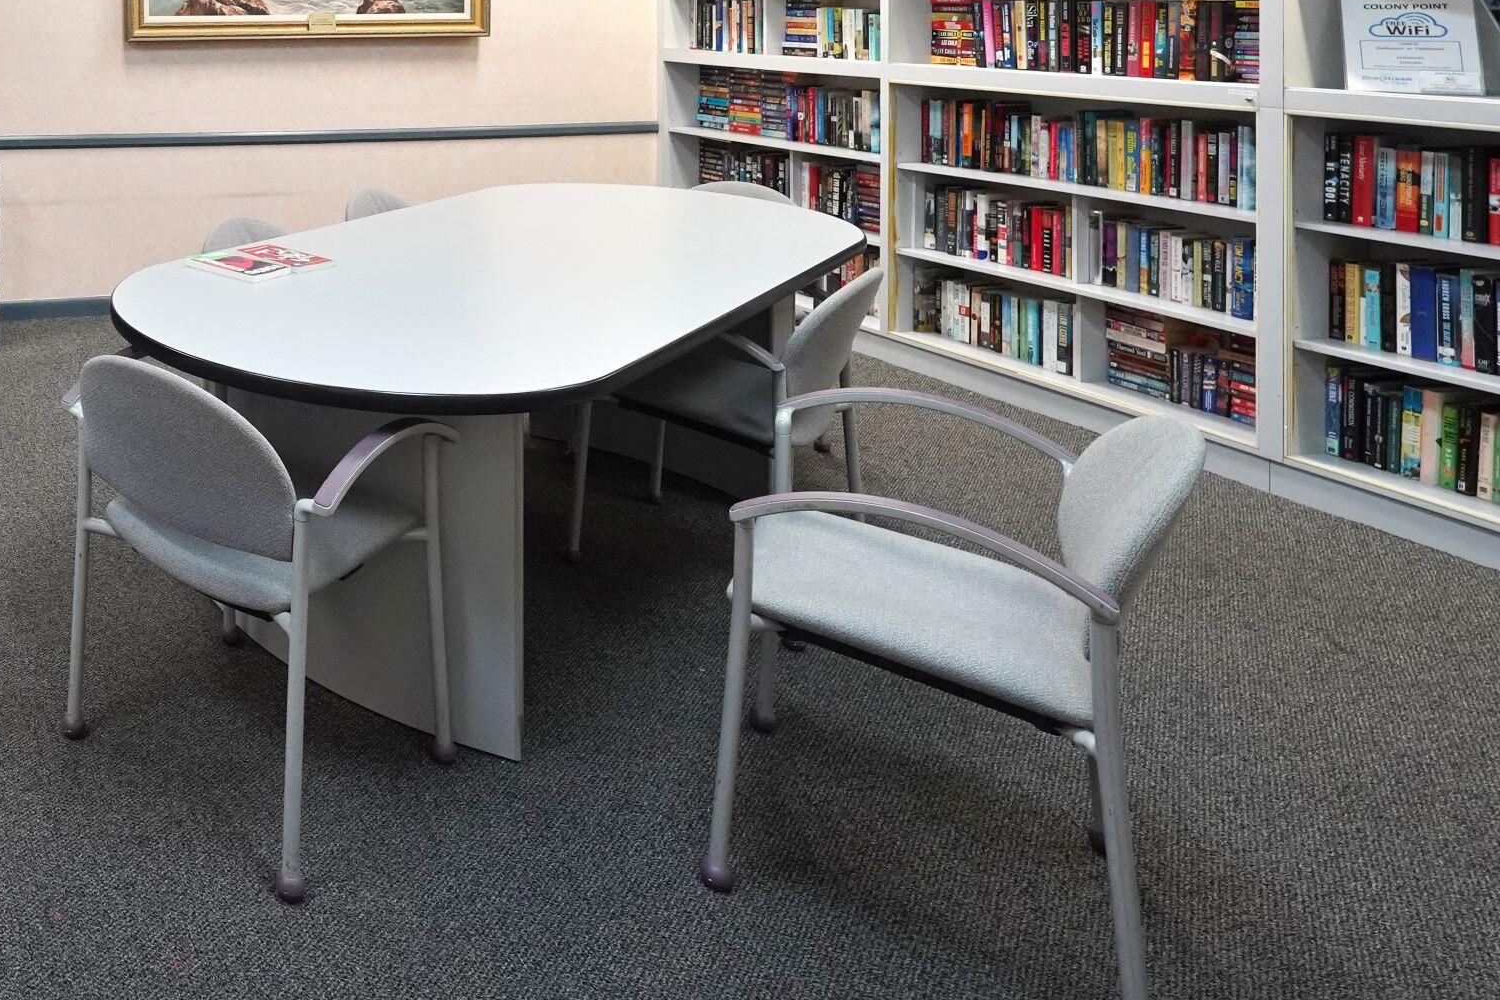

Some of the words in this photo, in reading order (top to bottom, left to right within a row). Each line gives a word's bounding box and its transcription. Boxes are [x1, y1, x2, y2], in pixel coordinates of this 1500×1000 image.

[1026, 5, 1037, 28] Silva
[1386, 26, 1430, 35] WiFi
[1340, 152, 1351, 205] TENACITY
[1325, 180, 1336, 204] COOL
[1234, 257, 1243, 285] CLANCY
[1441, 280, 1449, 302] ANDREW
